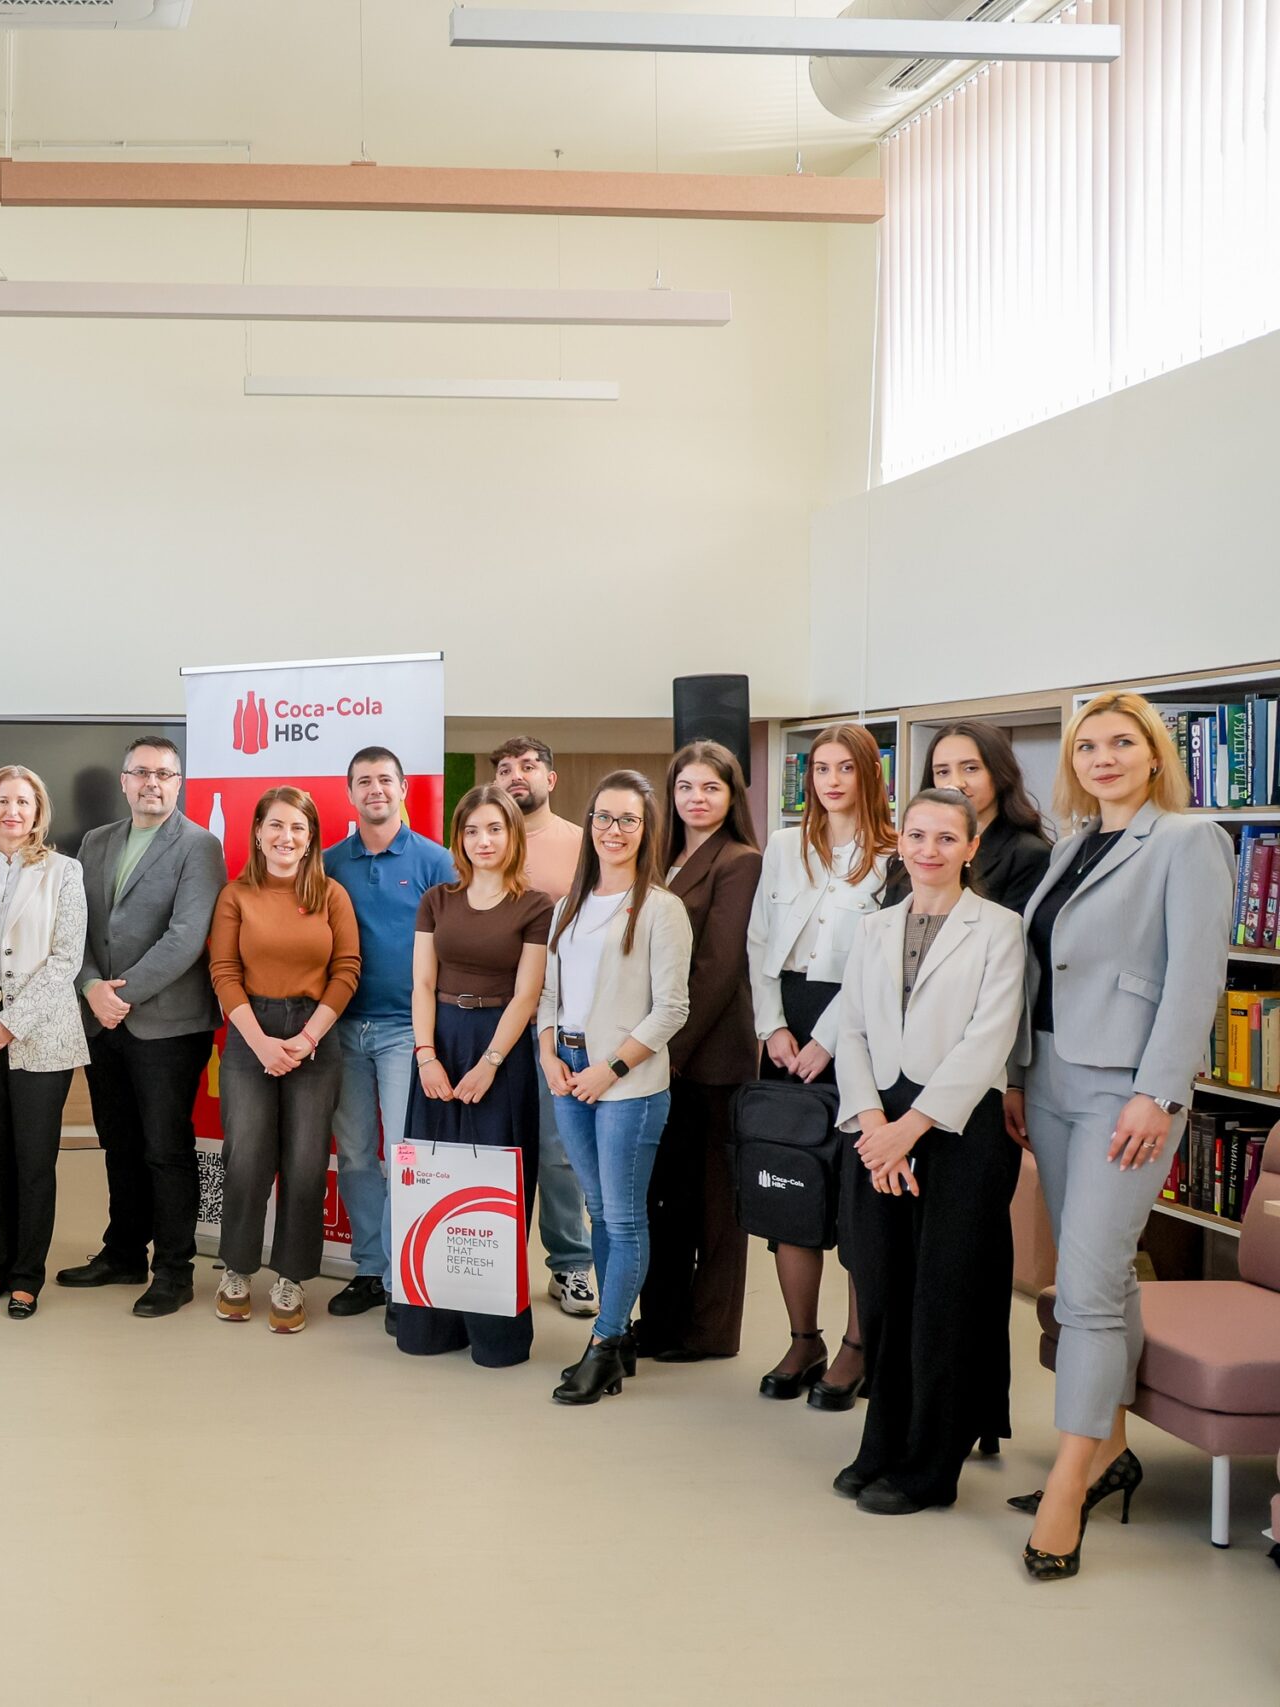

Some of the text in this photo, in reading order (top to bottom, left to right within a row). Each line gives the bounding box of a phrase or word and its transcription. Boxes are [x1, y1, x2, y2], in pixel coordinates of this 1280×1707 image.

[274, 697, 382, 718] Coca-Cola
[275, 723, 319, 742] HBC
[1192, 724, 1200, 757] 501
[416, 1171, 450, 1179] Coca-Cola
[772, 1175, 804, 1187] Coca-Cola
[772, 1181, 786, 1189] HBC
[447, 1227, 493, 1238] OPEN UP
[447, 1236, 499, 1248] MOMENTS
[448, 1246, 472, 1255] THAT
[447, 1256, 494, 1268] REFRESH
[447, 1266, 483, 1276] US ALL
